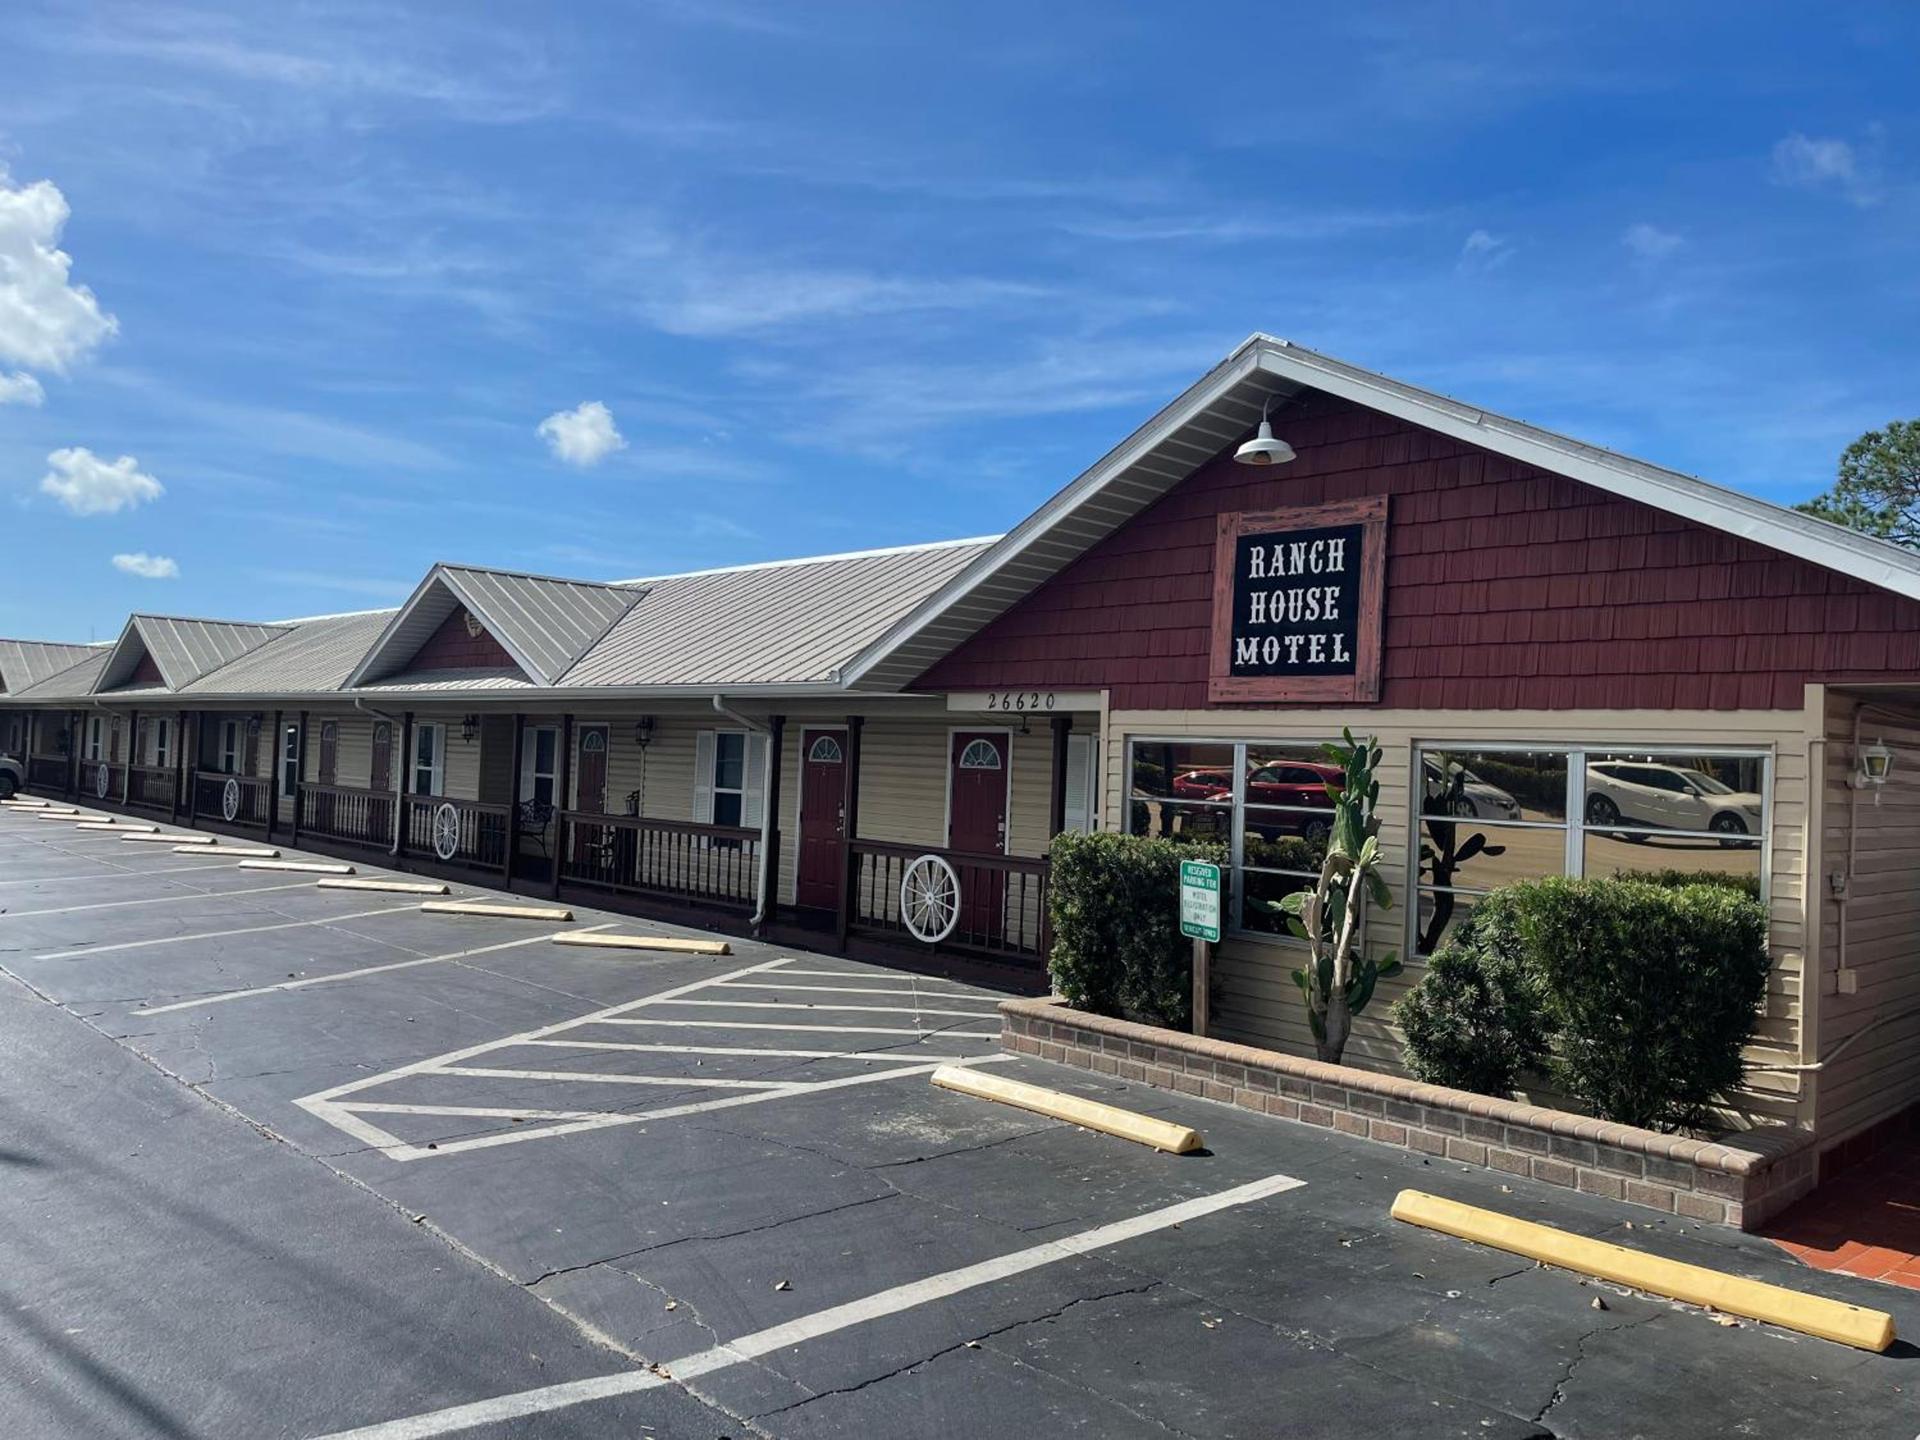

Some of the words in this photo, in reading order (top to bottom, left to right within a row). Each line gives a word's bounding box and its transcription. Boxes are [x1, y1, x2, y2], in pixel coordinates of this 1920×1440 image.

[1249, 538, 1346, 578] RANCH
[1249, 586, 1341, 624] HOUSE
[1235, 634, 1350, 665] MOTEL
[988, 692, 1055, 710] 26620
[1184, 875, 1205, 887] PARKING
[1206, 879, 1217, 889] FOR
